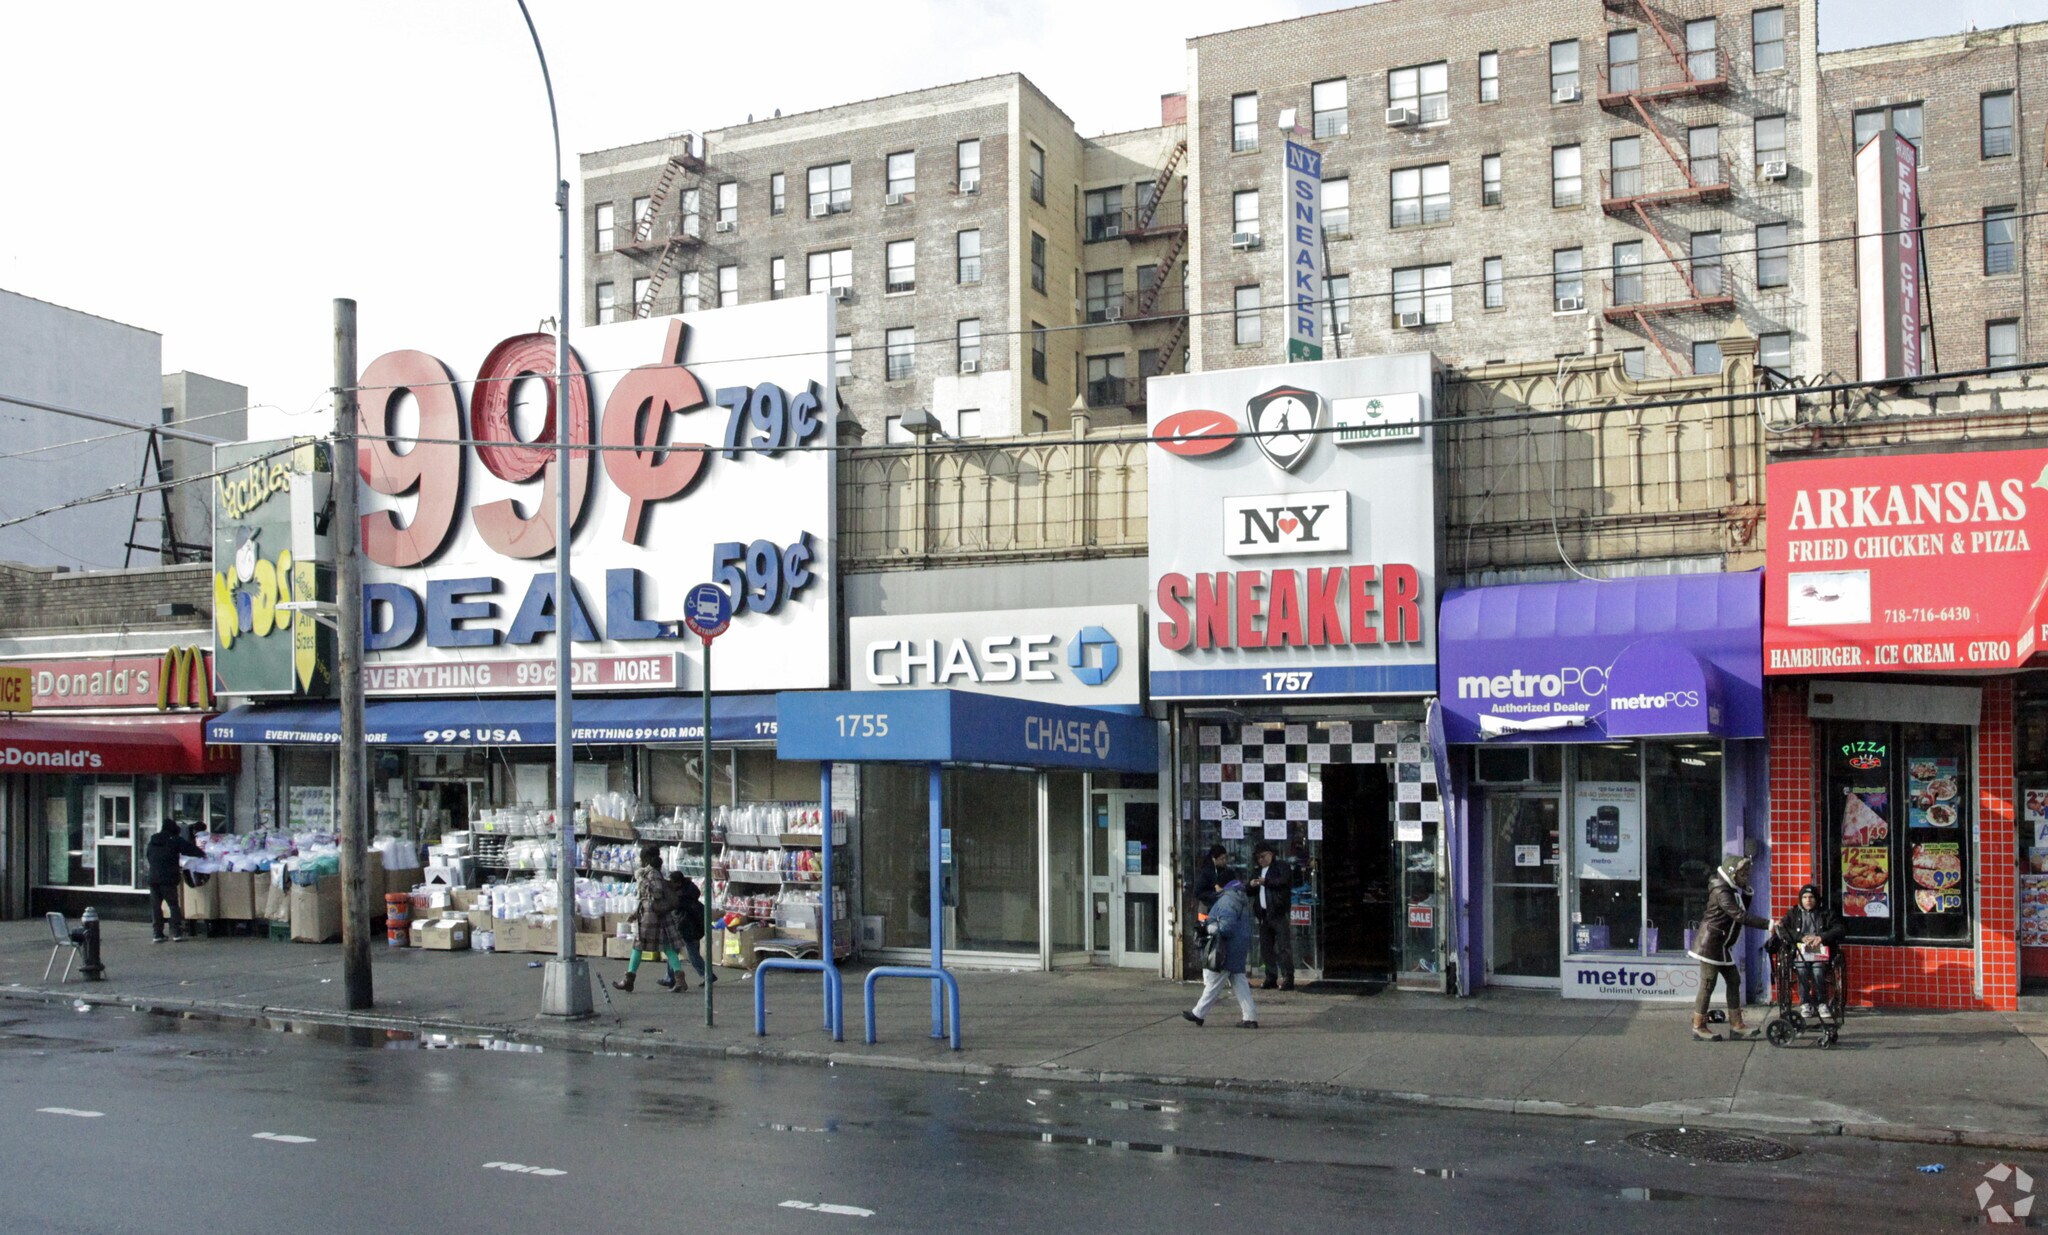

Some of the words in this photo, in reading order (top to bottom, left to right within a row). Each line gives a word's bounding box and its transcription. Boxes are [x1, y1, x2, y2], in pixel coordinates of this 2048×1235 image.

[1290, 146, 1318, 173] NY
[1898, 161, 1912, 249] FRIED
[1295, 179, 1315, 338] SNEAKER
[716, 379, 822, 459] 79¢
[1788, 479, 2027, 531] ARKANSAS
[1788, 540, 1848, 562] FRIED
[1853, 533, 1944, 560] CHICKEN
[1950, 532, 1965, 554] &
[1971, 529, 2031, 554] PIZZA
[712, 530, 814, 614] 59¢
[364, 568, 684, 649] DEAL
[1157, 563, 1421, 651] SNEAKER
[1884, 606, 1971, 624] 718-716-6430
[697, 622, 728, 636] STANDING
[865, 634, 1056, 685] CHASE
[1770, 647, 1861, 669] HAMBURGER
[1874, 645, 1899, 664] ICE
[1903, 643, 1955, 663] CREAM
[1968, 641, 2011, 662] GYRO
[31, 669, 150, 697] Donald's
[516, 661, 556, 687] 99¢
[614, 659, 661, 681] MORE
[1262, 671, 1314, 692] 1757
[0, 677, 22, 702] ICE
[1611, 691, 1699, 710] metroPCS
[1491, 703, 1550, 714] Authorized
[1553, 702, 1591, 712] Dealer
[212, 728, 234, 739] 1751
[265, 730, 323, 741] EVERYTHING
[364, 733, 388, 743] ORE
[423, 729, 471, 743] 99¢
[477, 729, 522, 742] USA
[571, 728, 635, 740] VERYTHING
[660, 728, 677, 738] OR
[679, 726, 705, 738] MOR
[754, 722, 777, 734] 175
[835, 714, 888, 738] 1755
[1024, 716, 1092, 754] CHASE
[0, 747, 103, 768] Donald's
[1842, 741, 1886, 757] PIZZA
[1842, 847, 1860, 866] 12
[1290, 910, 1310, 920] SALE
[1410, 912, 1431, 923] SALE
[1577, 966, 1699, 988] metroPCS
[1599, 986, 1633, 994] Unlimit
